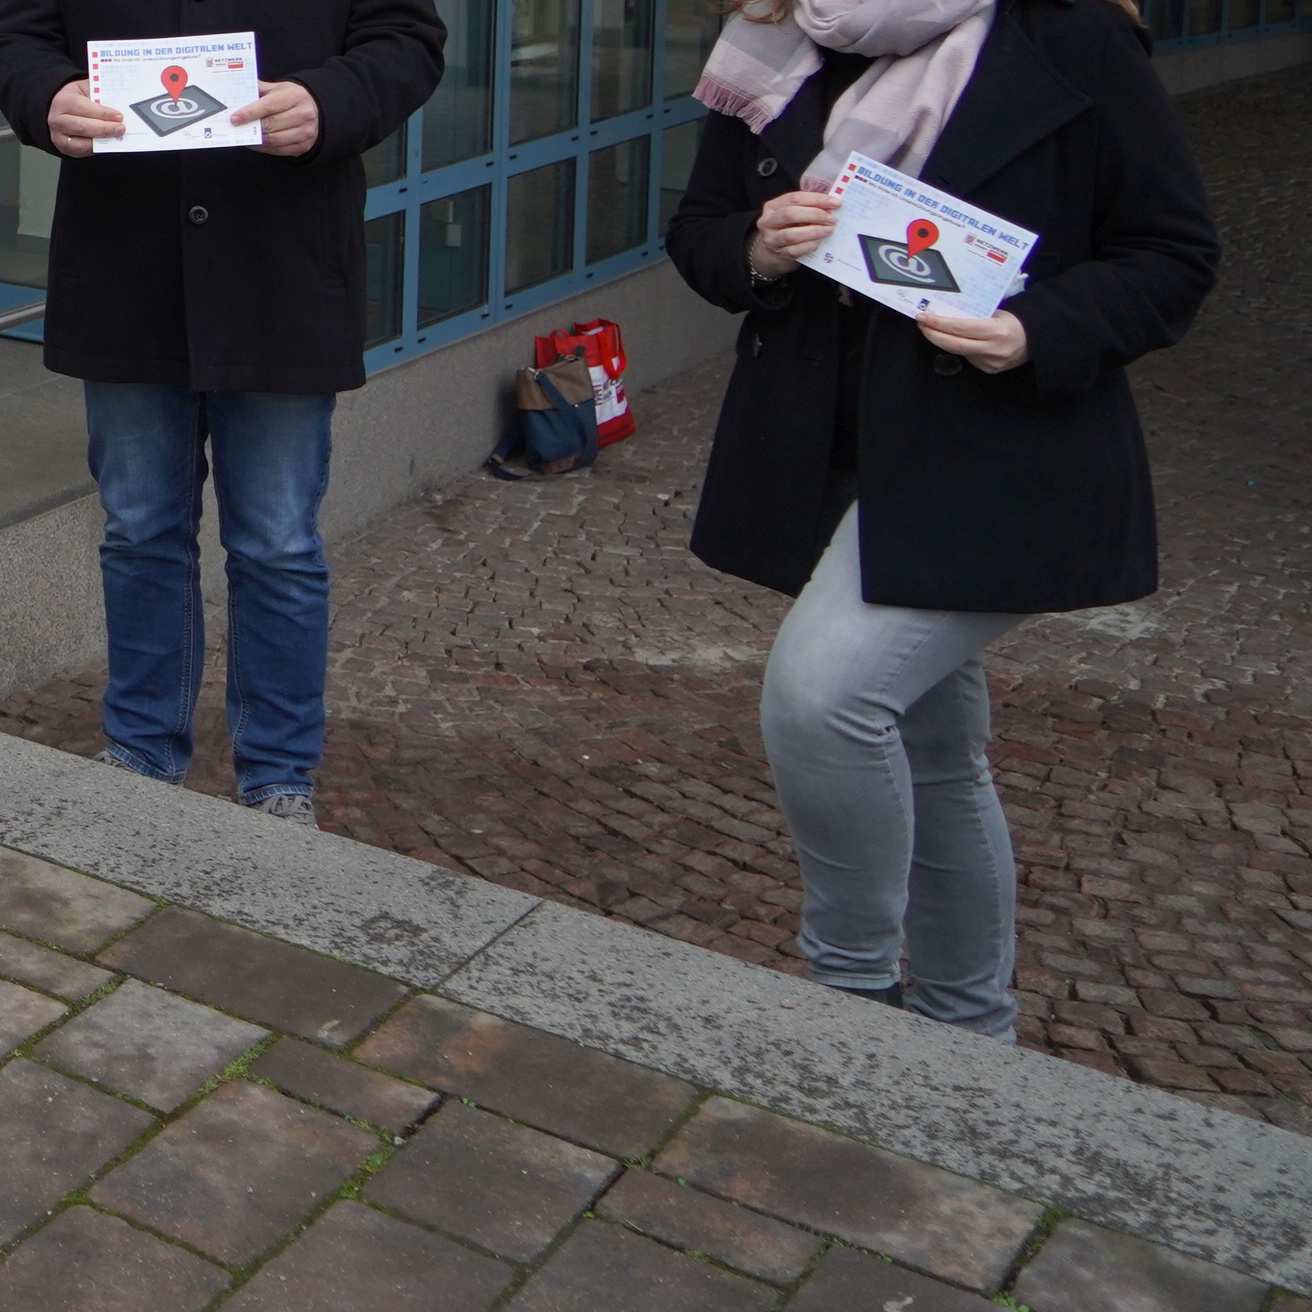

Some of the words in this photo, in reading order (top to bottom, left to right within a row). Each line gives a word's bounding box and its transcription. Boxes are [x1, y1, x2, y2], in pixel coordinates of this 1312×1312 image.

[100, 49, 140, 57] BILDUNG
[142, 48, 152, 56] IN
[154, 47, 173, 55] DER
[175, 45, 224, 54] DIGITALEN
[227, 42, 252, 51] WELT
[857, 166, 903, 192] BILDUNG
[903, 186, 916, 198] IN
[917, 193, 939, 210] DER
[939, 203, 997, 235] DIGITALEN
[997, 230, 1030, 251] WELT
